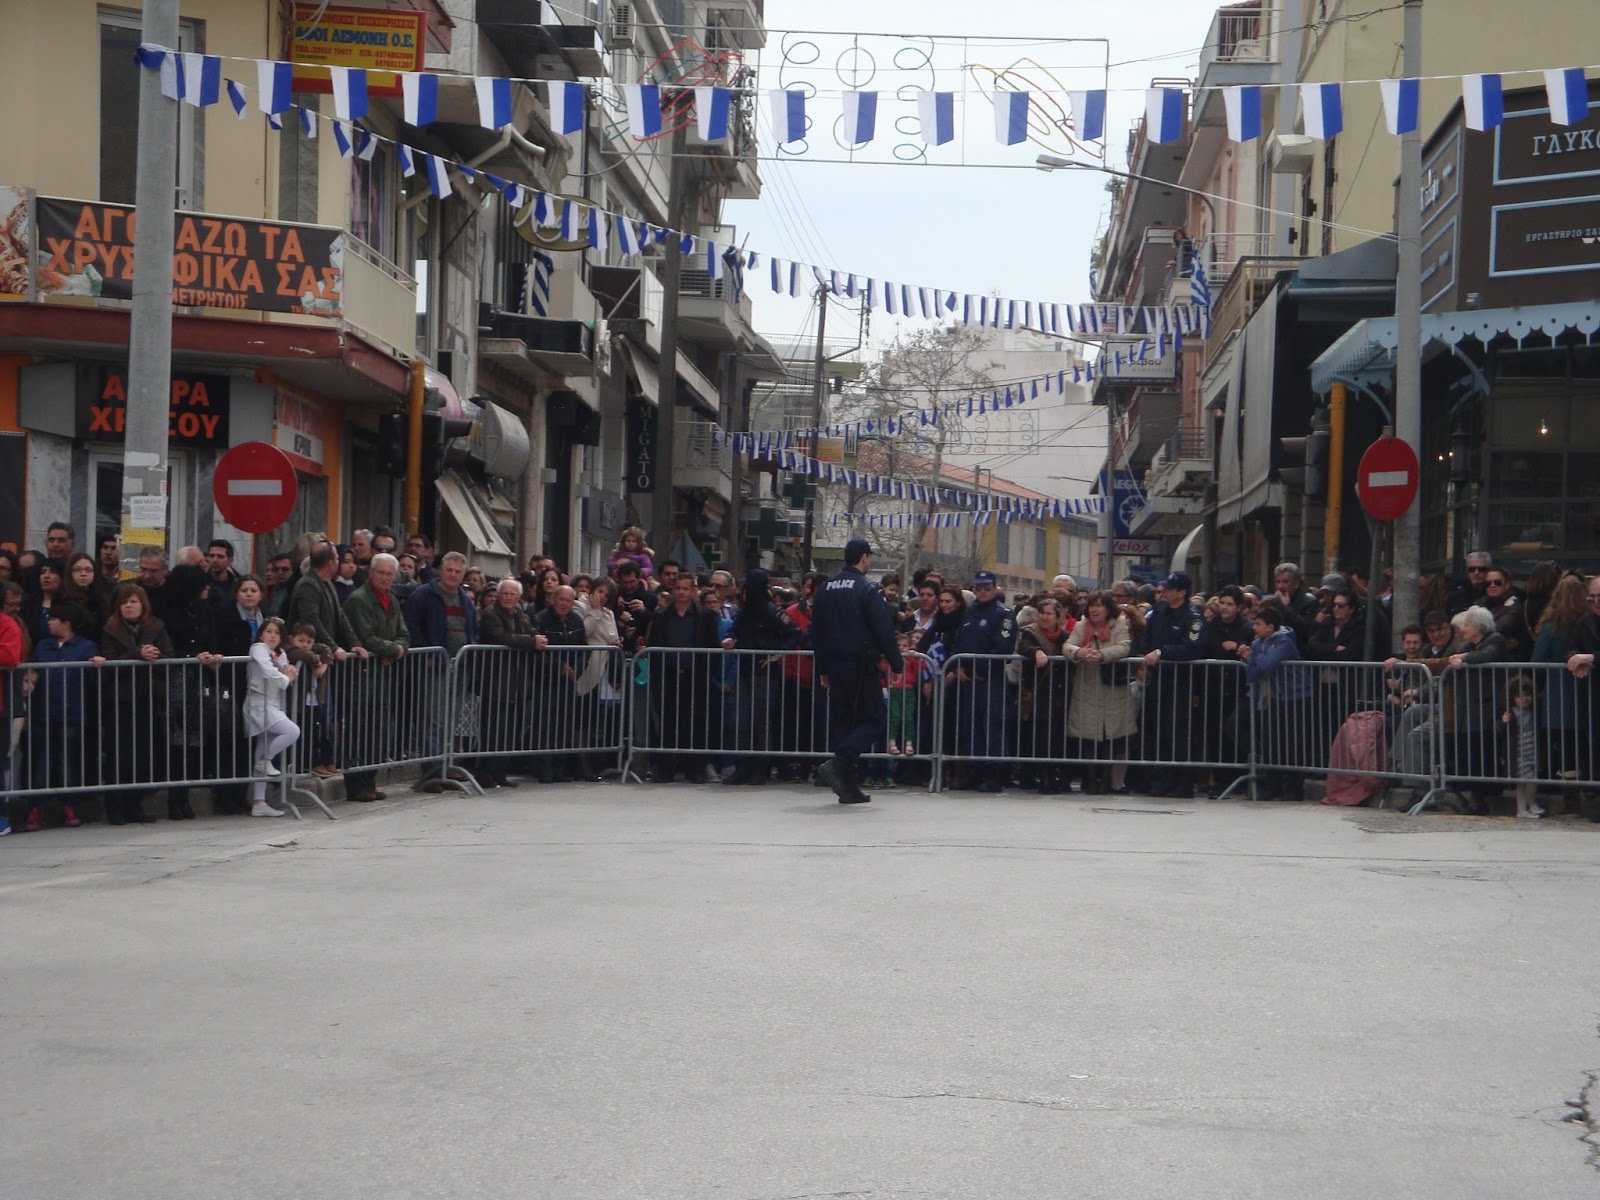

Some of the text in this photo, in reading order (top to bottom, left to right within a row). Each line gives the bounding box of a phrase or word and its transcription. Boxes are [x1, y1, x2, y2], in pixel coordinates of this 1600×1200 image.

[75, 206, 247, 258] ΑΓΑΖΩ
[259, 225, 305, 263] ΤΑ
[1525, 229, 1583, 242] ΕΡΓΑΣΤΗΡΙΟ
[45, 237, 341, 300] ΧΡΥΣΦΙΚΑ ΣΑΣ
[102, 375, 209, 407] ΑΡΑ
[88, 406, 220, 439] ΧΡΟΥ
[826, 579, 856, 591] POLICE
